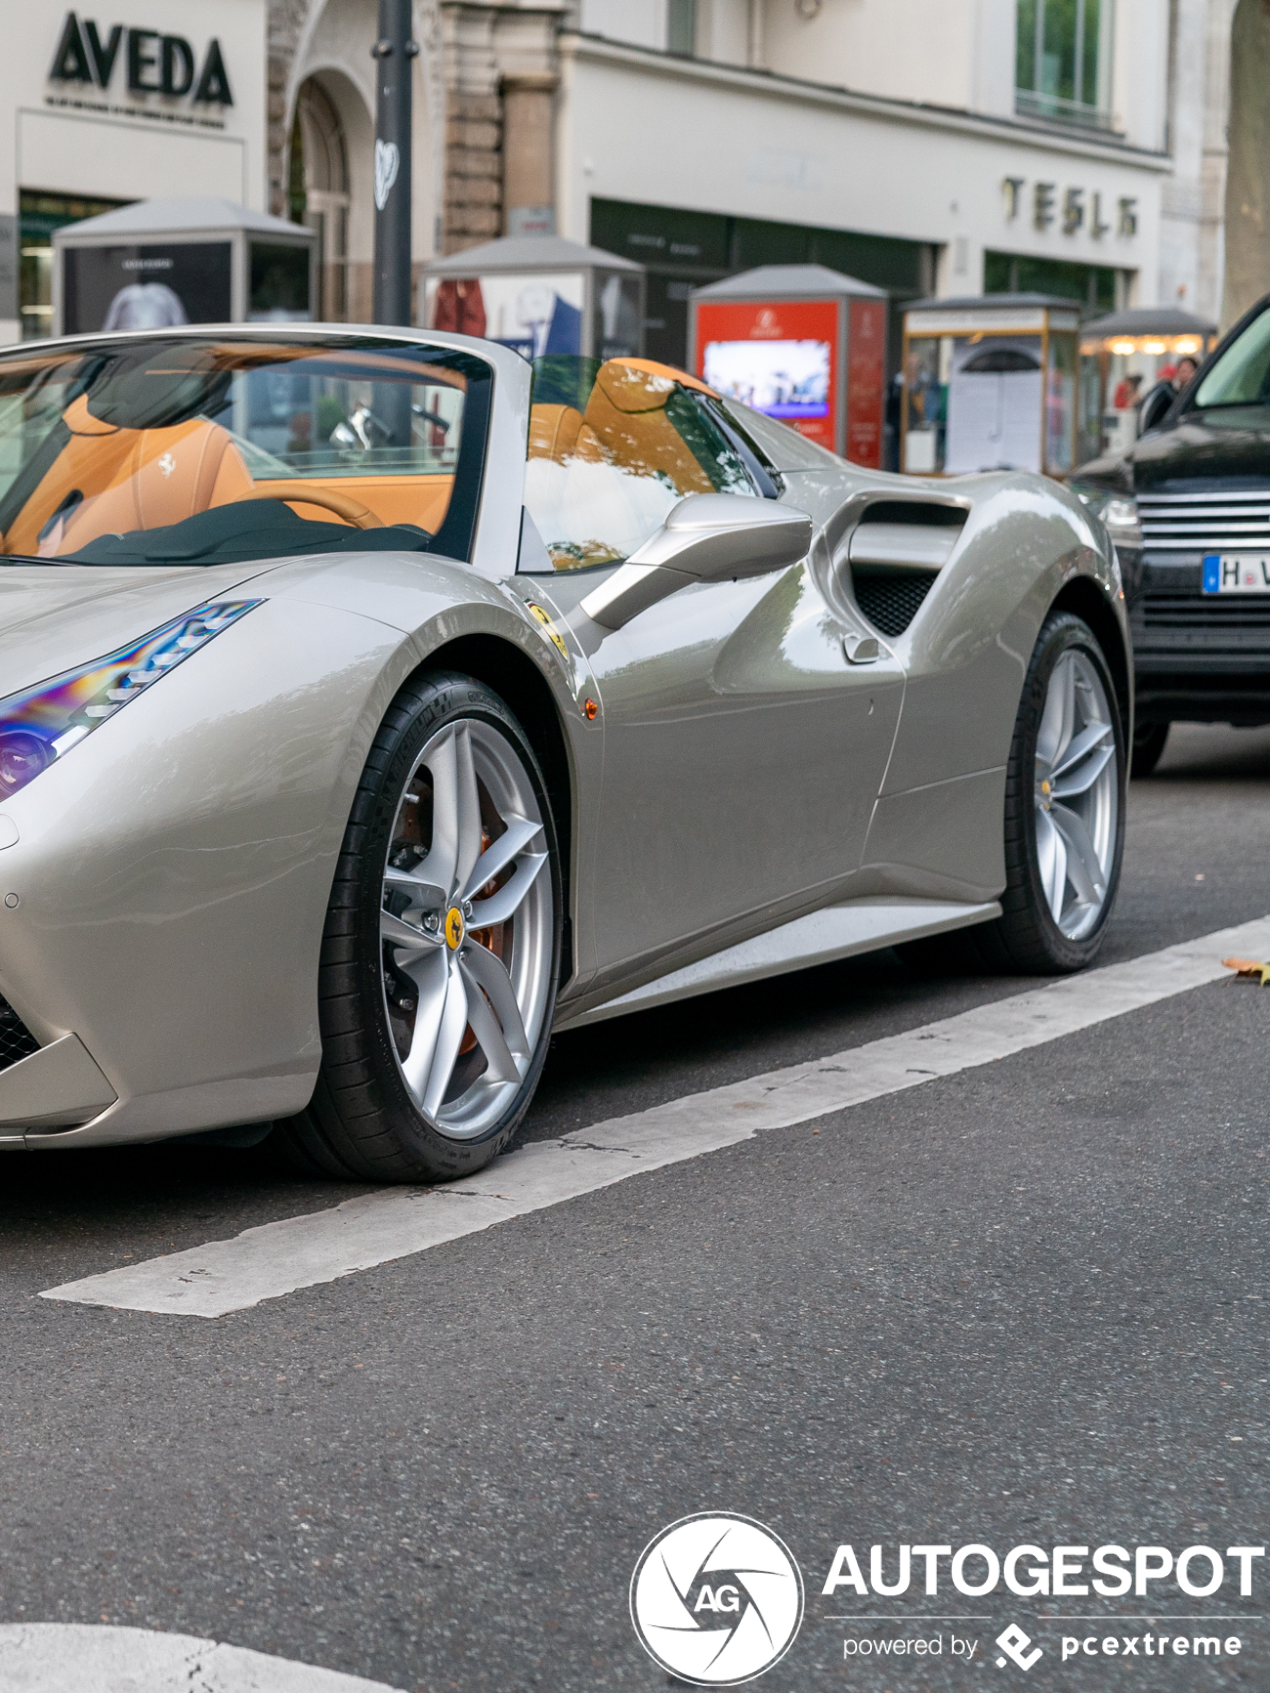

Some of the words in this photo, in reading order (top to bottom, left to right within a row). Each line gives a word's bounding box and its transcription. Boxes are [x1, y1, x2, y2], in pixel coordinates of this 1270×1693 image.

[48, 10, 233, 107] AVEDA
[1002, 175, 1138, 240] TESLA
[1223, 562, 1238, 585] H
